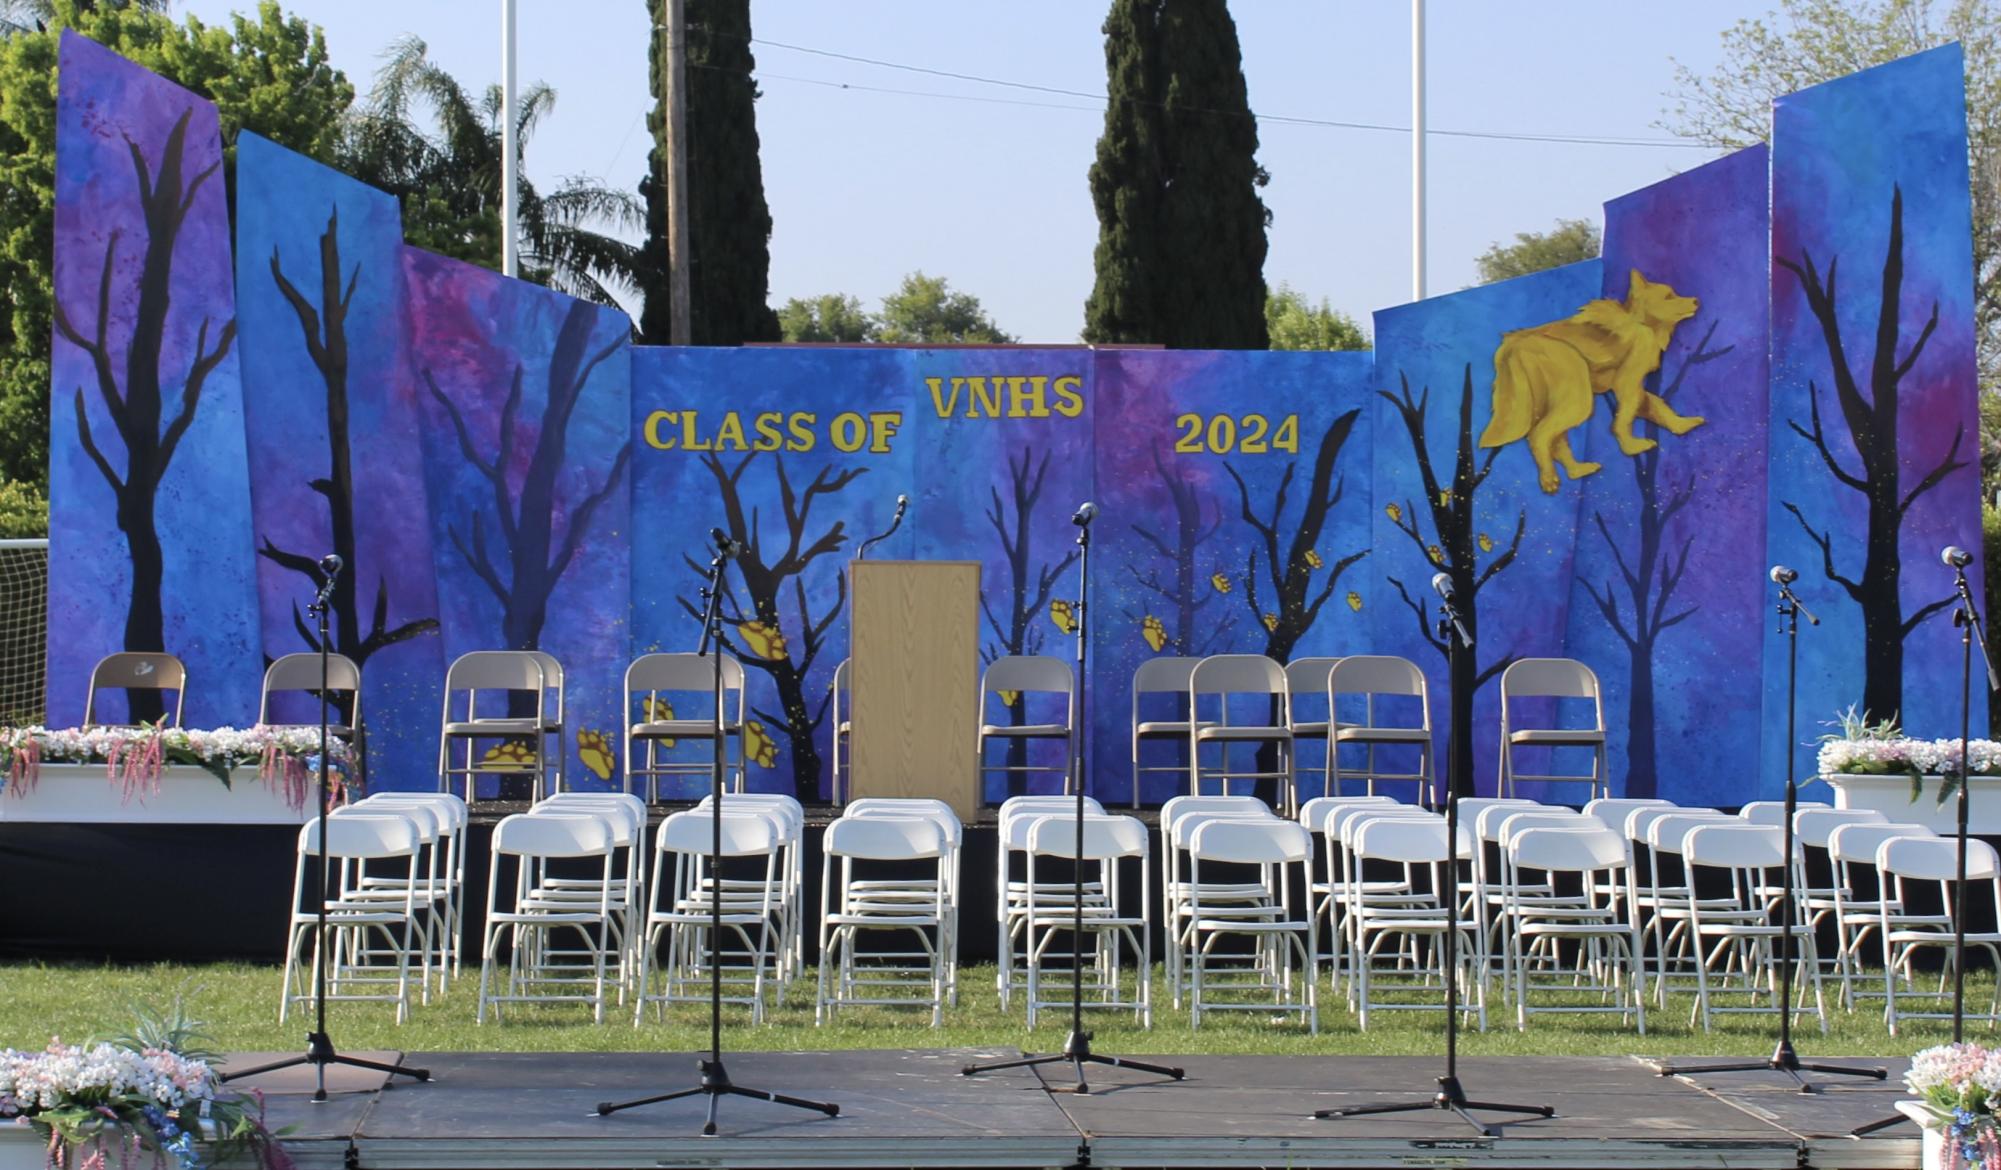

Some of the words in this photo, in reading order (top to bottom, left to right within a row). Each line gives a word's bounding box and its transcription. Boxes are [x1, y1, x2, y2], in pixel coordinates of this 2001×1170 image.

[926, 375, 1085, 419] VNHS
[643, 410, 817, 453] CLASS
[829, 411, 903, 453] OF
[1174, 412, 1299, 455] 2024
